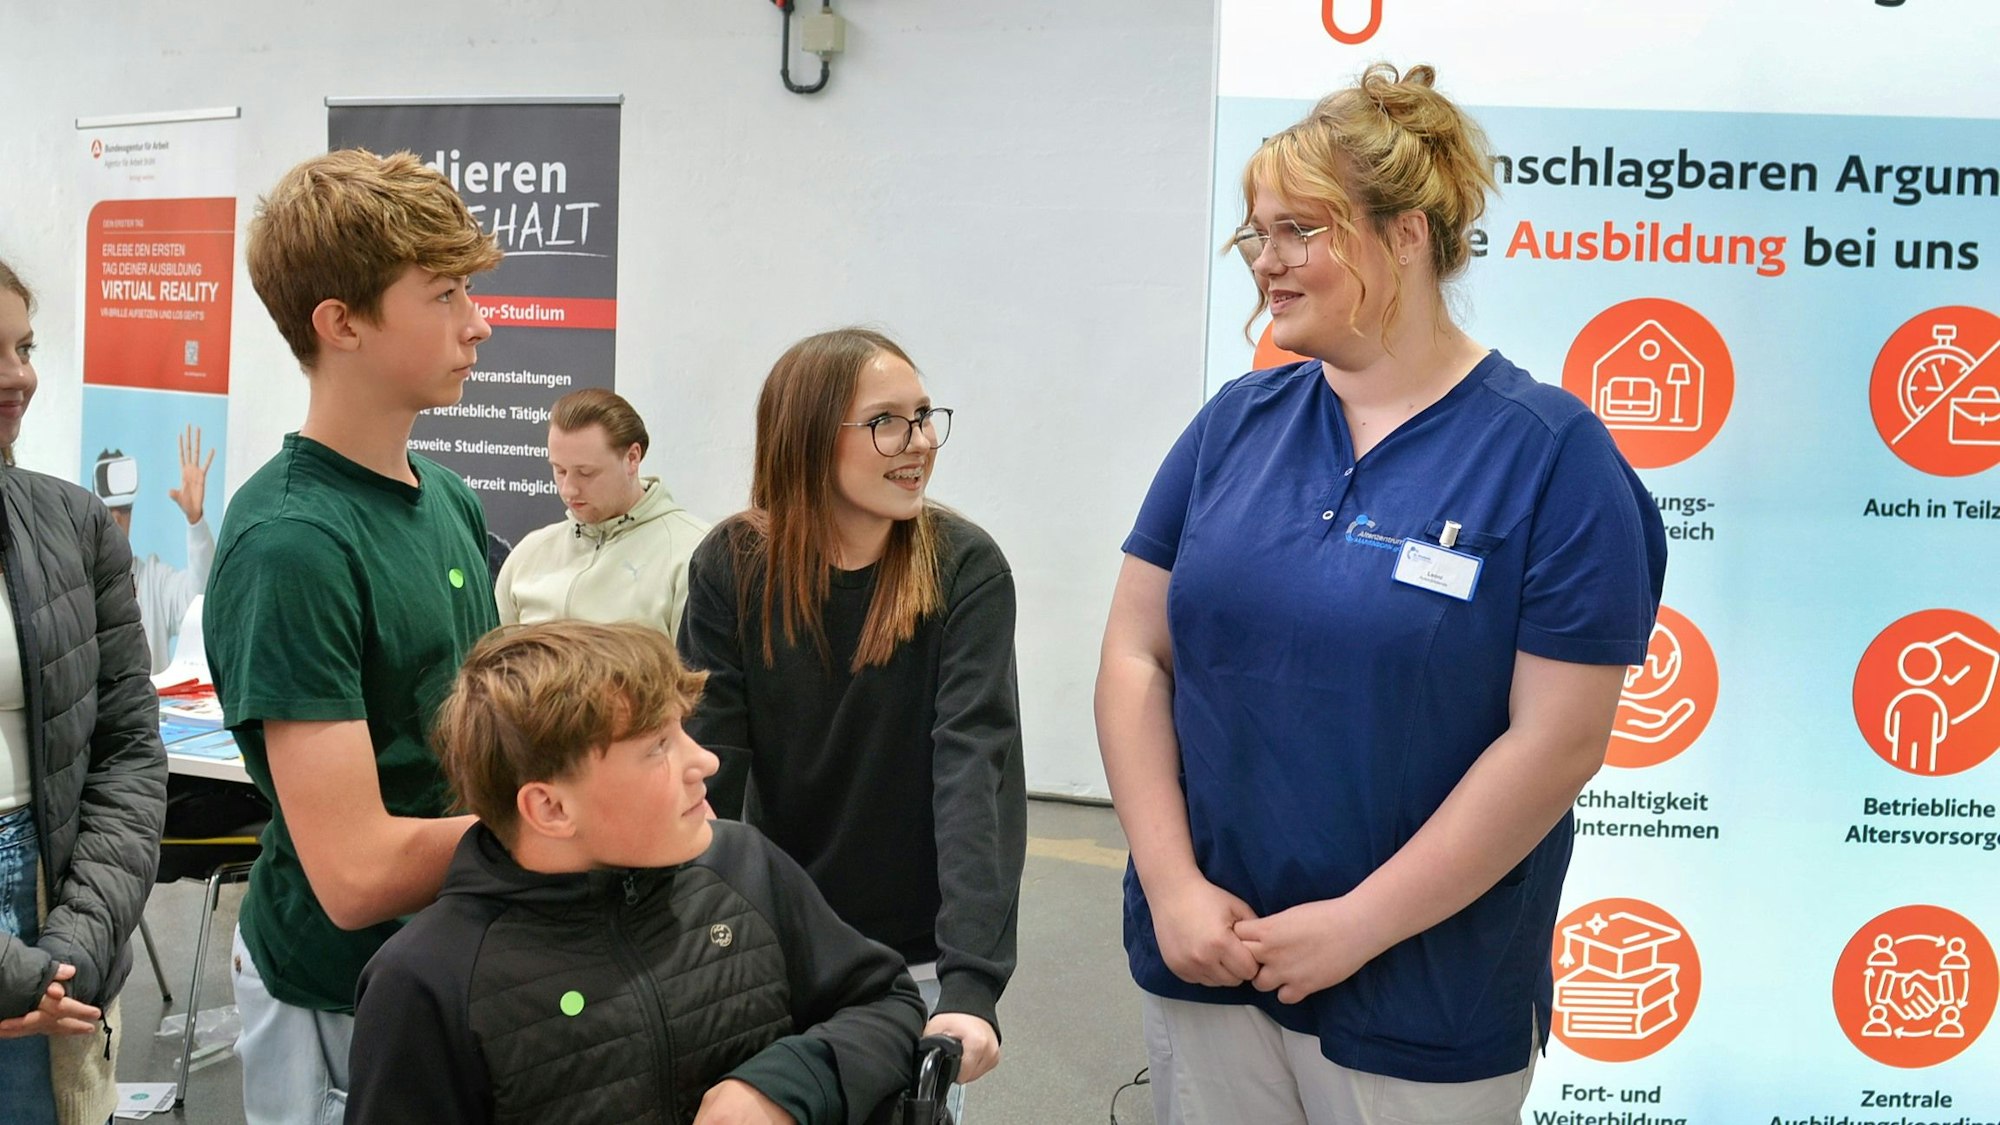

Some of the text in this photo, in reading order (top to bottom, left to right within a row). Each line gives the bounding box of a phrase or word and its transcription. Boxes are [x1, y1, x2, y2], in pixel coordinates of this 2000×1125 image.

[152, 141, 169, 150] Arbeit
[1836, 155, 2000, 206] Argum
[102, 243, 185, 257] ERLEBE DEN ERSTEN
[1506, 220, 1787, 276] Ausbildung
[1804, 226, 1876, 268] bei
[1895, 239, 1979, 270] uns
[102, 262, 202, 276] TAG DEINER AUSBILDUNG
[101, 280, 219, 303] VIRTUAL REALITY
[466, 370, 572, 388] veranstaltungen
[433, 403, 506, 419] betriebliche
[455, 439, 549, 458] Studienzentren
[509, 478, 558, 496] möglich
[1650, 491, 1715, 516] ungs-
[1863, 498, 1920, 517] Auch
[1927, 499, 1947, 518] in
[1863, 797, 1996, 818] Betriebliche
[1562, 1083, 1661, 1103] Fort- und
[1860, 1089, 1953, 1108] Zentrale
